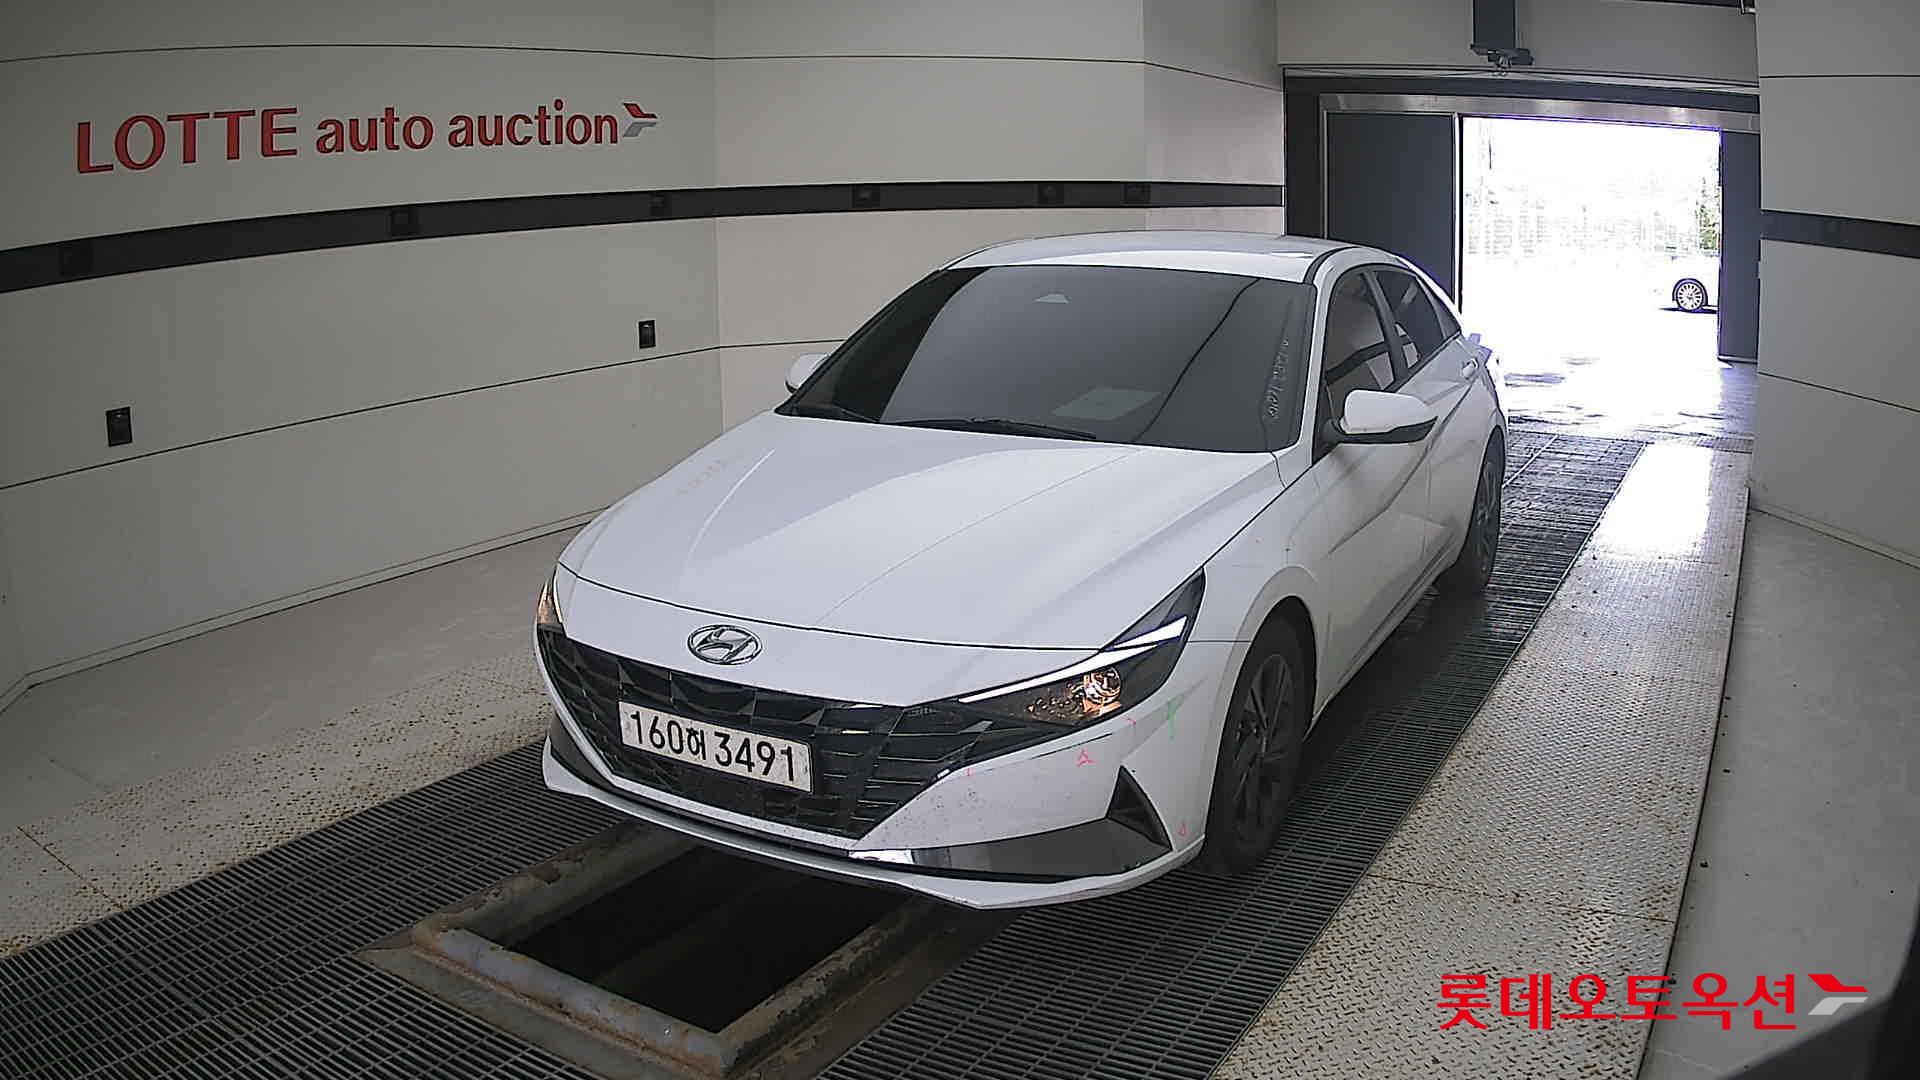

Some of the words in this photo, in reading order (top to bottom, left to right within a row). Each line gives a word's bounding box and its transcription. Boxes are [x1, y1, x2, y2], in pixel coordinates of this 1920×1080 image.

[76, 107, 297, 174] LOTTE
[316, 107, 434, 154] auto
[447, 99, 620, 148] auction
[714, 731, 794, 782] 3491
